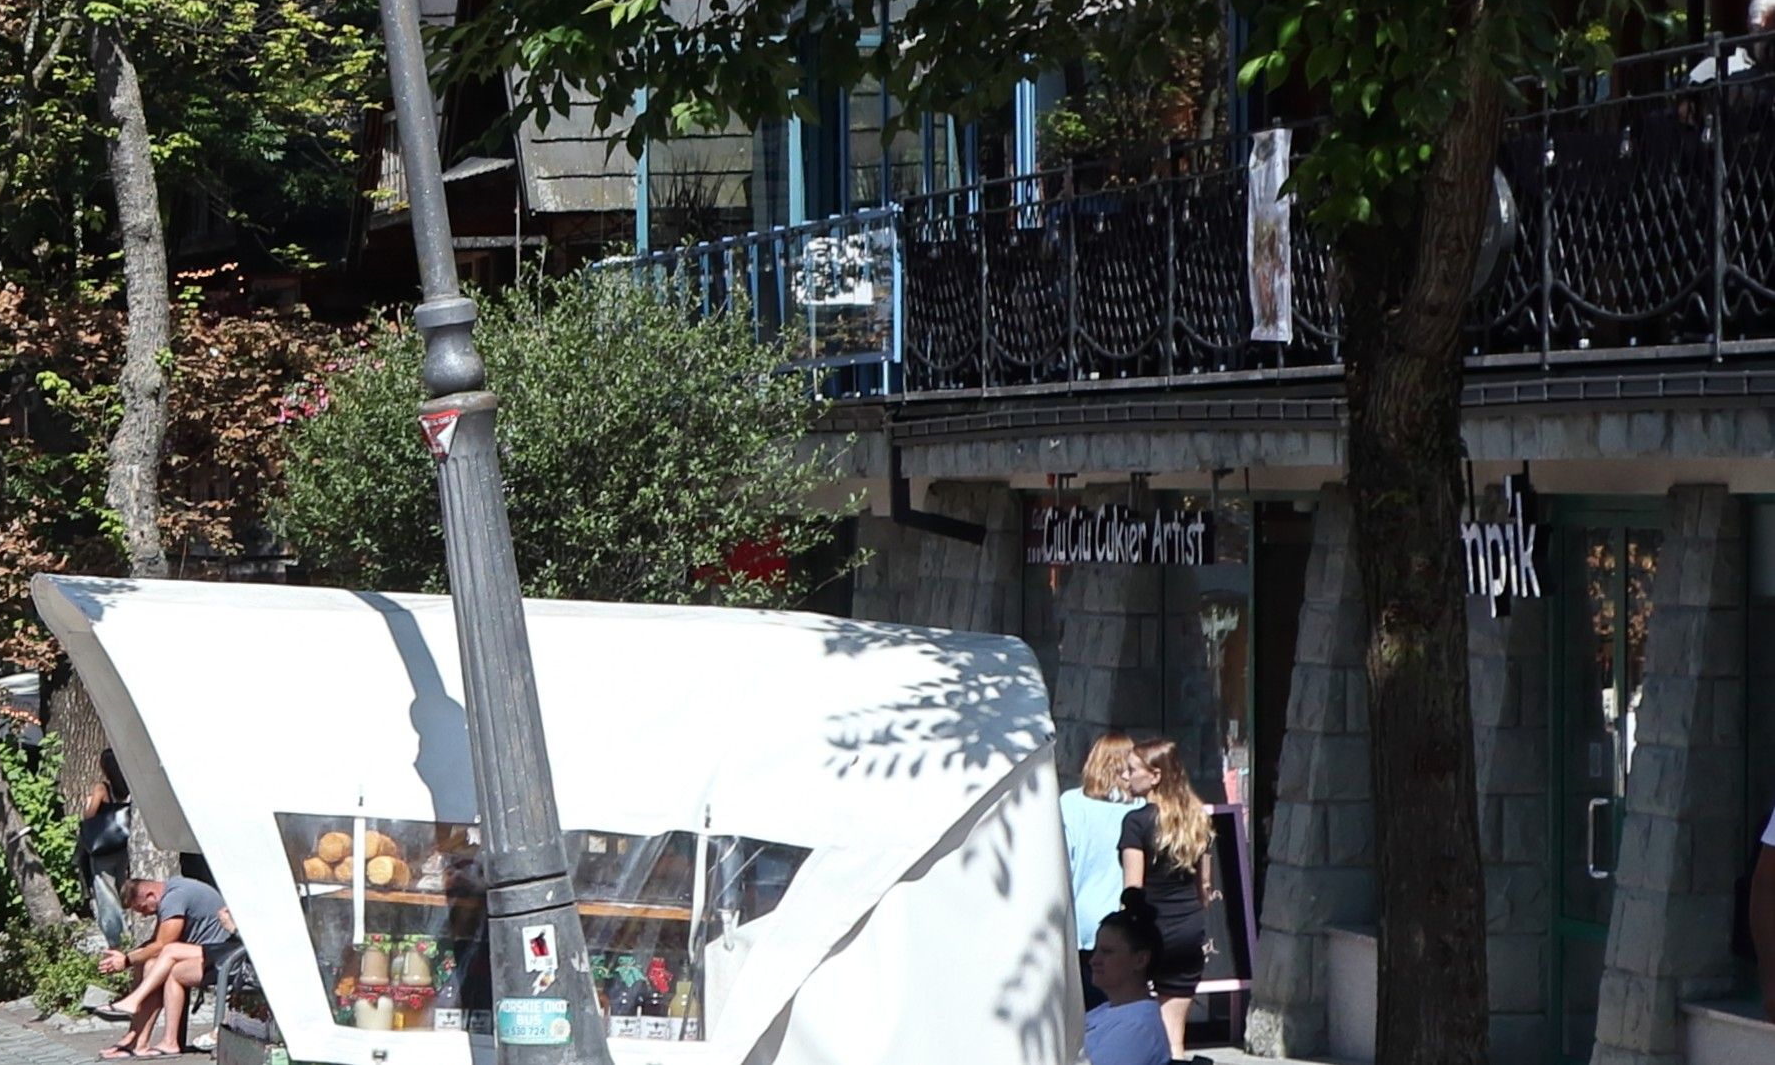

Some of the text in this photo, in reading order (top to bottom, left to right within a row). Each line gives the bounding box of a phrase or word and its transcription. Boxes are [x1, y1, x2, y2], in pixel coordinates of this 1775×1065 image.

[1095, 502, 1147, 563] Cukier
[1151, 508, 1206, 565] Artist
[1460, 475, 1542, 619] mpik
